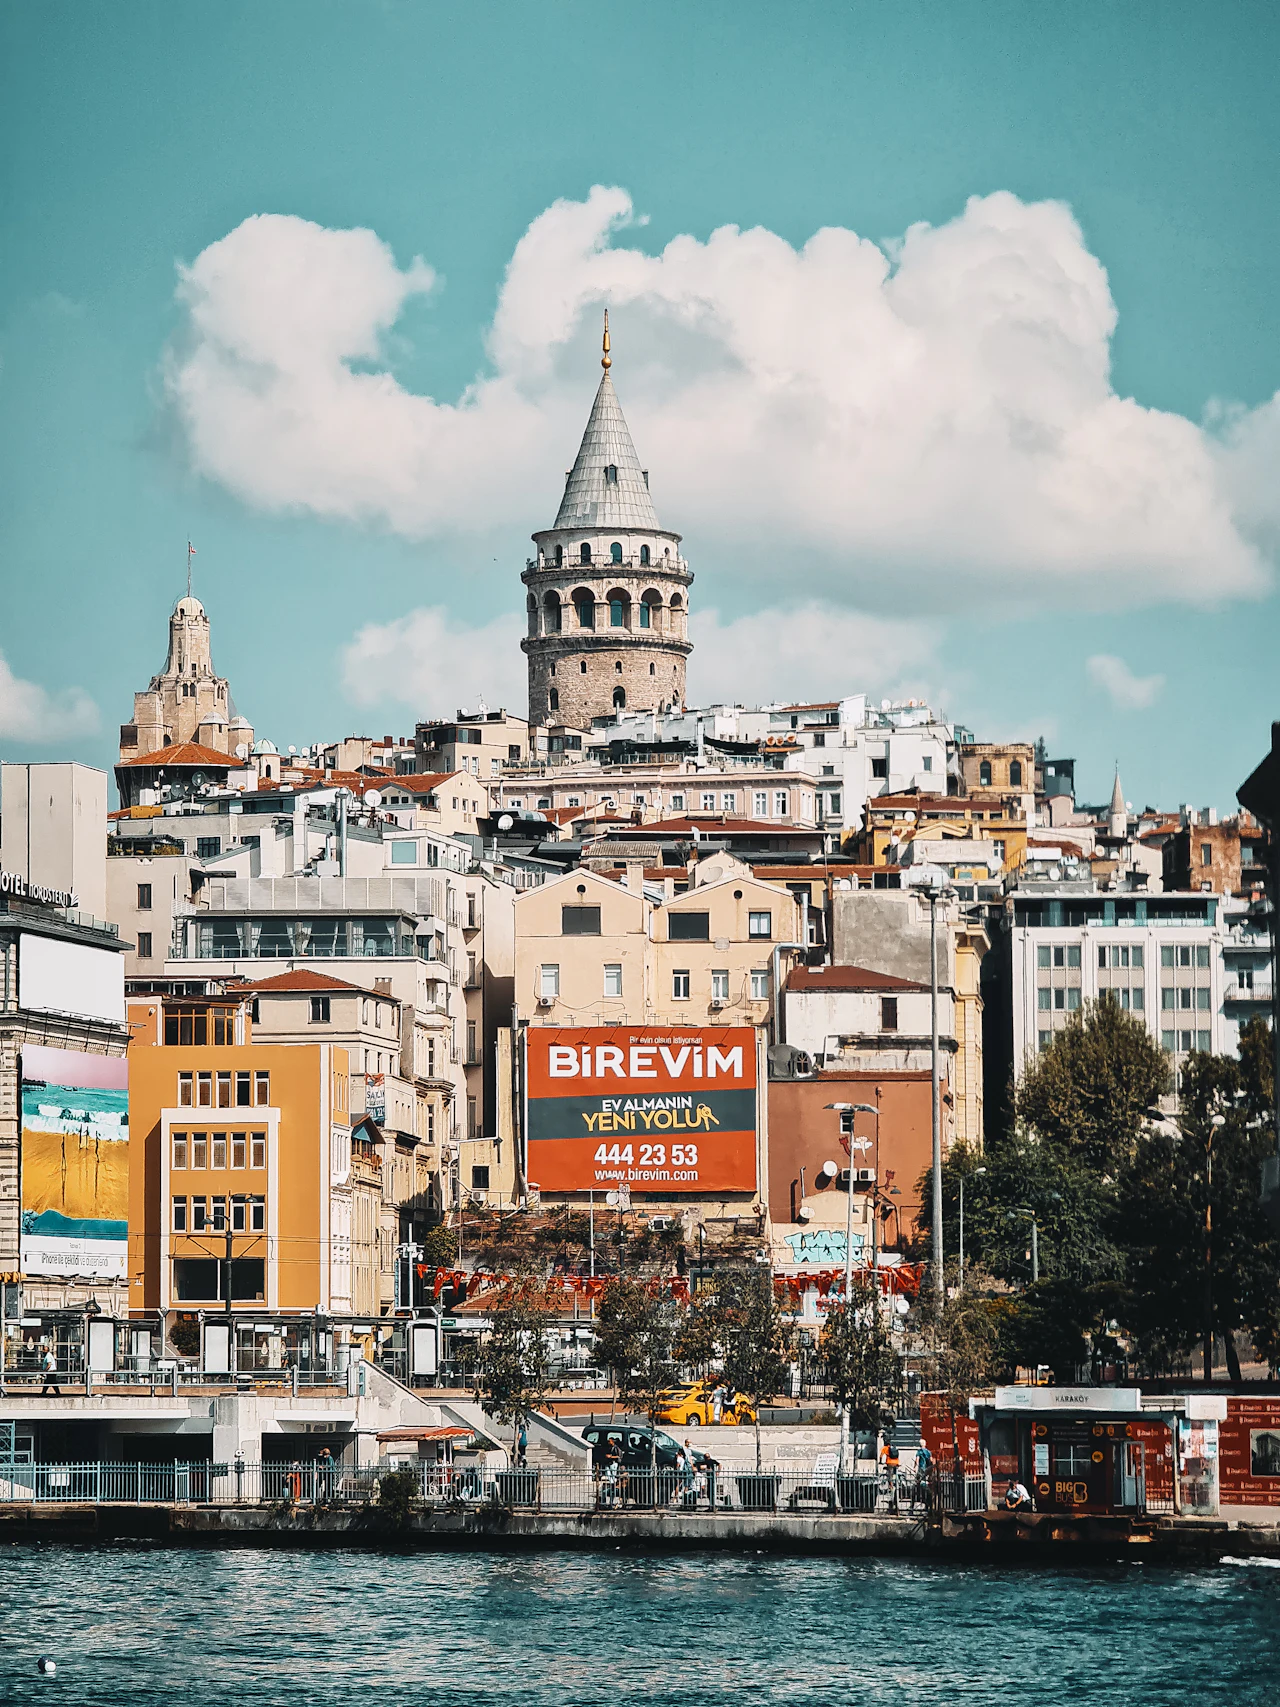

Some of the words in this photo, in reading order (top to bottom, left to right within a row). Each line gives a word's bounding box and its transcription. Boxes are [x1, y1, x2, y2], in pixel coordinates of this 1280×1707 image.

[0, 870, 26, 896] OTEL
[639, 1036, 654, 1044] evin
[654, 1036, 672, 1044] olsun
[672, 1036, 703, 1045] istiyorsan
[602, 1099, 622, 1112] EV
[623, 1096, 693, 1111] ALMANIN
[639, 1107, 703, 1130] YOLU
[594, 1143, 634, 1166] 444
[639, 1143, 666, 1166] 23
[671, 1143, 698, 1166] 53
[594, 1168, 698, 1181] www.birevim.com
[1055, 1481, 1074, 1493] BIG
[1055, 1492, 1074, 1502] BUS
